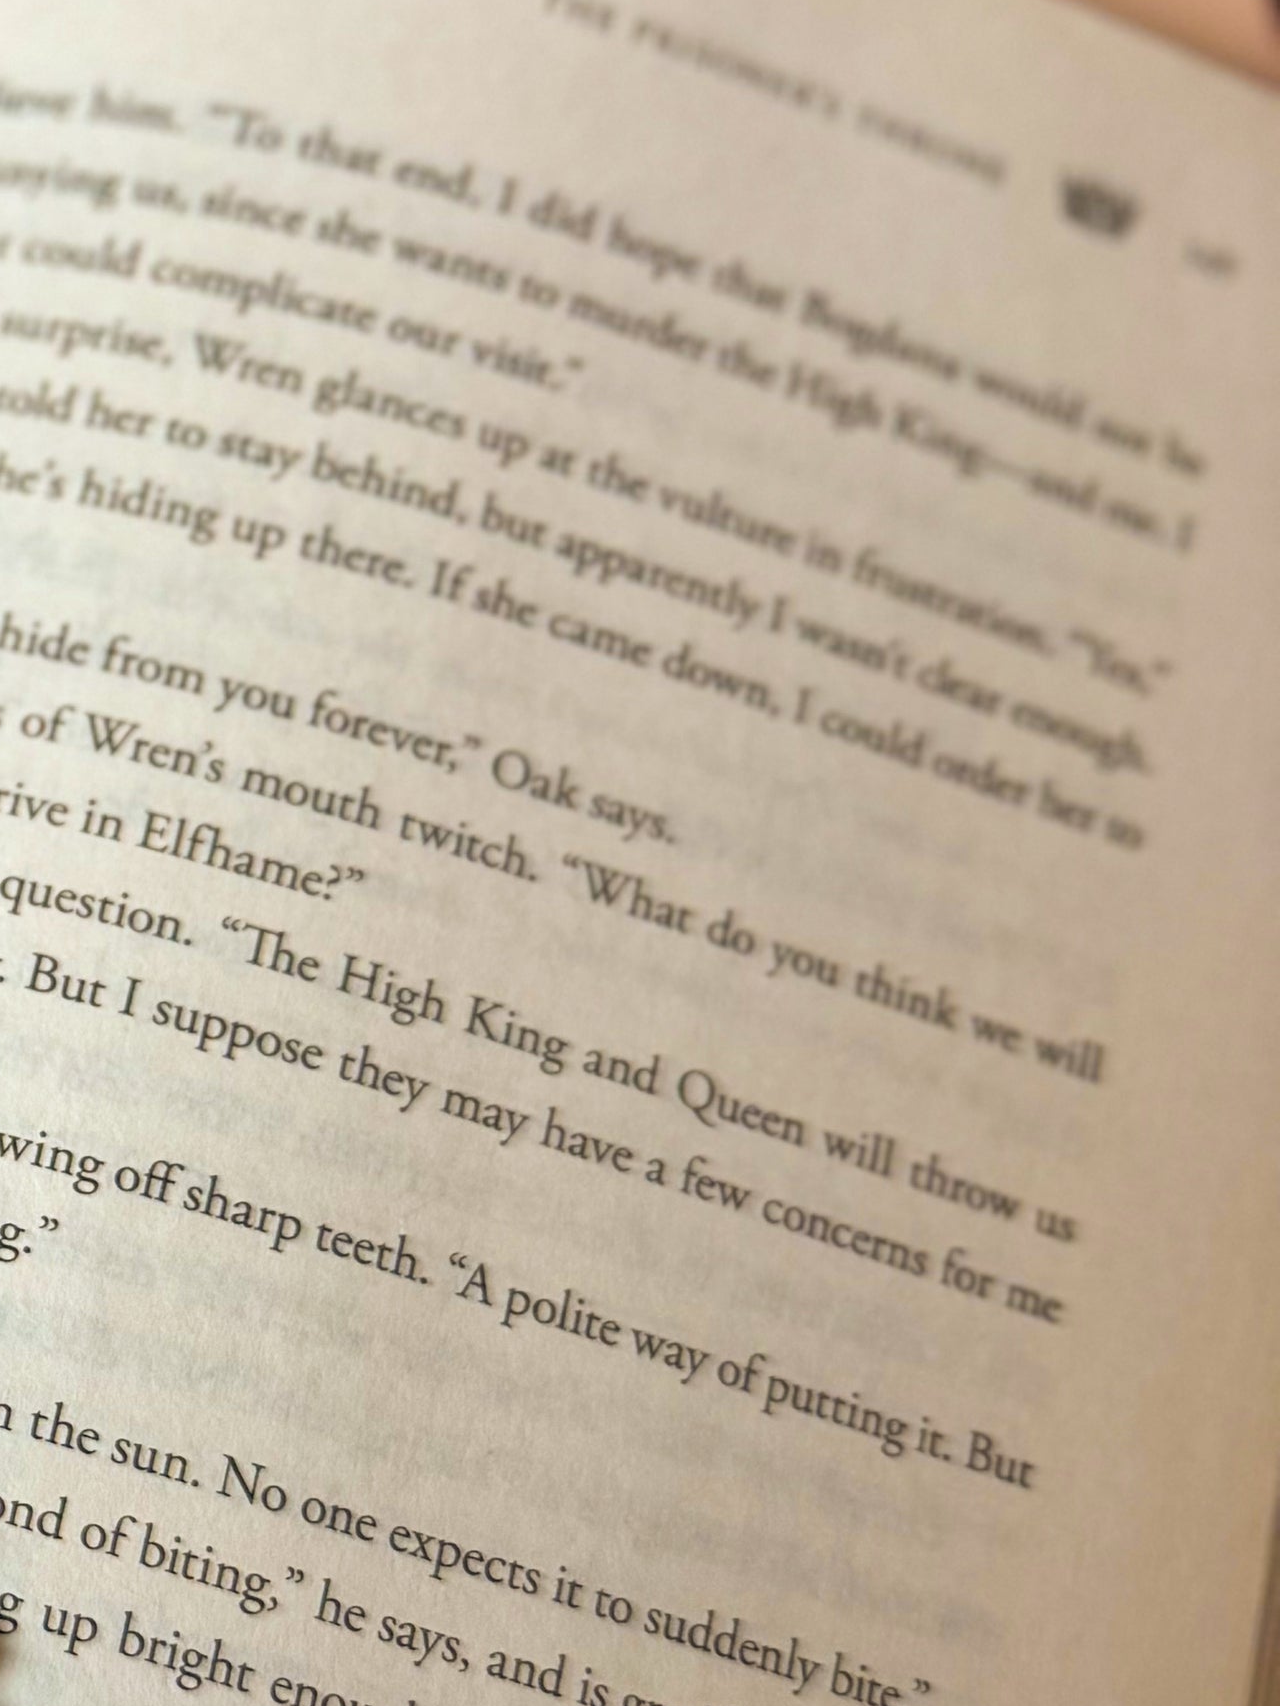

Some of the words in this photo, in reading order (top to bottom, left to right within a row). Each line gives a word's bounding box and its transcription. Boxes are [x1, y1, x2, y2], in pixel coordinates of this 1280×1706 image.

[97, 635, 209, 698] from
[213, 676, 297, 722] you
[305, 687, 488, 775] forever,”
[490, 749, 579, 811] Oak
[586, 792, 678, 848] says.
[81, 799, 123, 842] in
[138, 811, 366, 901] Elfhame?”
[220, 915, 322, 984] “The
[335, 953, 446, 1027] High
[463, 994, 570, 1077] King
[582, 1049, 661, 1097] and
[676, 1069, 805, 1148] Queen
[823, 1131, 896, 1178] will
[910, 1154, 1021, 1220] throw
[1036, 1210, 1076, 1242] us
[114, 1159, 187, 1204] off
[182, 1174, 304, 1254] sharp
[316, 1223, 429, 1285] teeth.
[448, 1252, 493, 1307] “A
[500, 1287, 622, 1347] polite
[631, 1328, 711, 1385] way
[717, 1353, 767, 1394] of
[762, 1375, 909, 1458] putting
[916, 1416, 951, 1462] it.
[965, 1430, 1035, 1489] But
[79, 1514, 132, 1554] of
[138, 1520, 307, 1618] biting,”
[314, 1577, 368, 1633] he
[377, 1615, 470, 1673] says,
[486, 1651, 567, 1698] and
